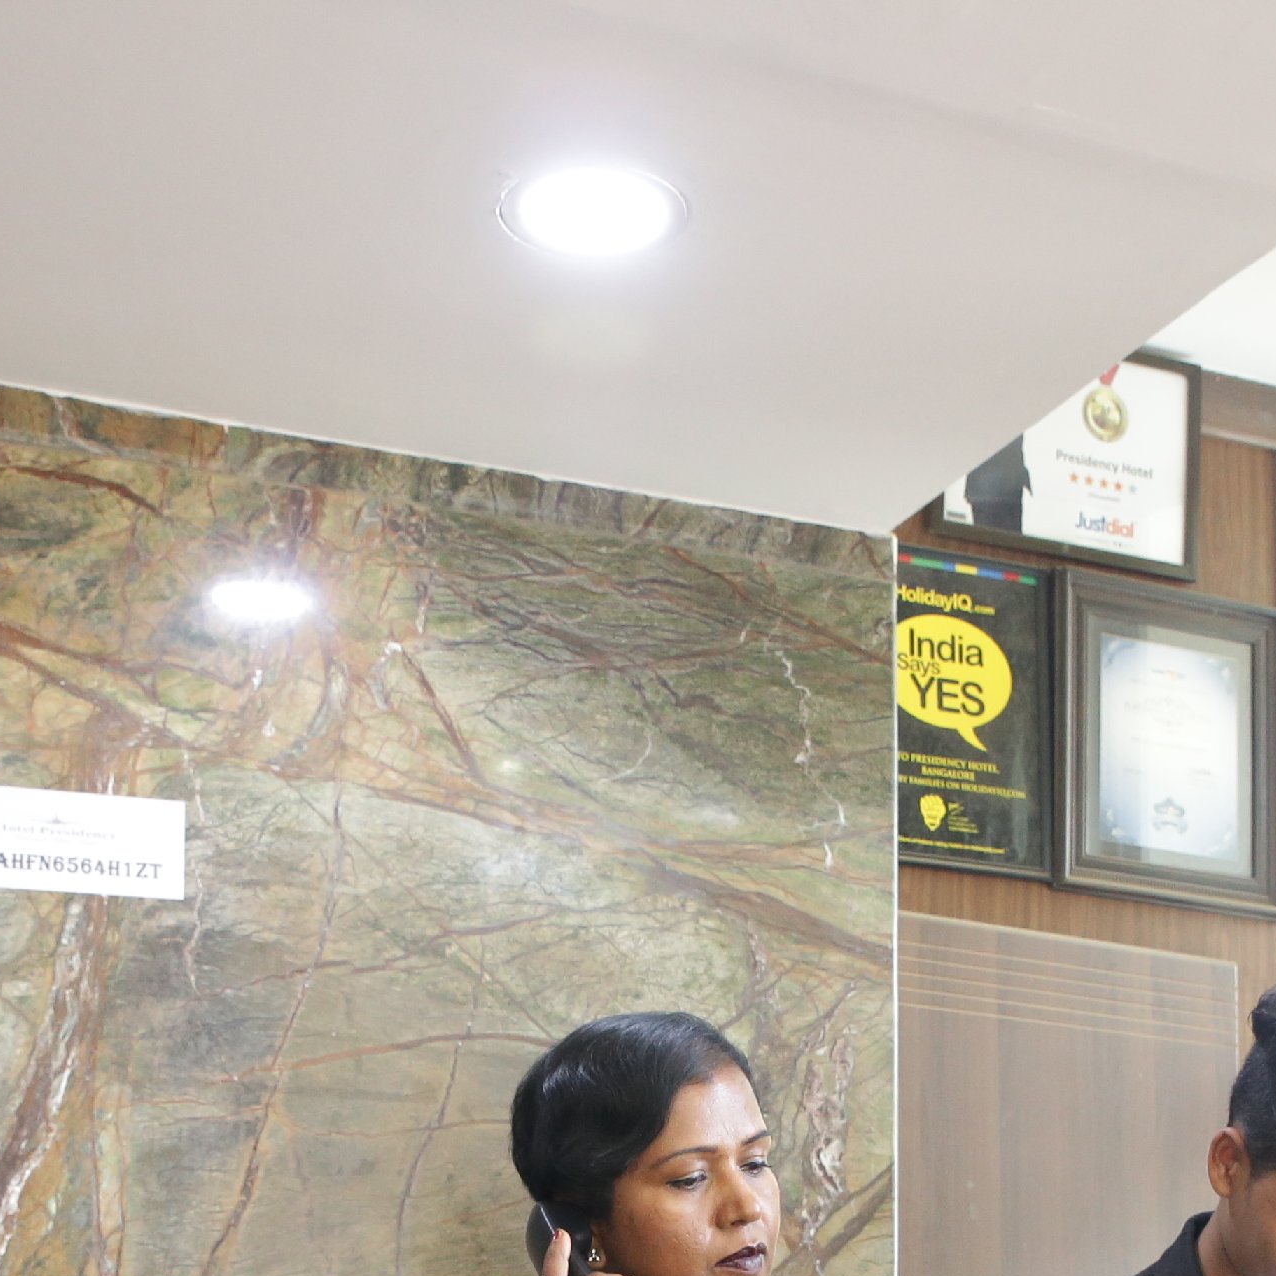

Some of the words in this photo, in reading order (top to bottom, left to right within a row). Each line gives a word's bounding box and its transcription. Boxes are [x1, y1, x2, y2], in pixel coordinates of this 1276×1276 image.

[1055, 448, 1120, 475] Presidency
[1122, 462, 1153, 479] Hotel
[1075, 511, 1135, 538] Justdial
[909, 628, 984, 668] India
[910, 673, 985, 717] YES
